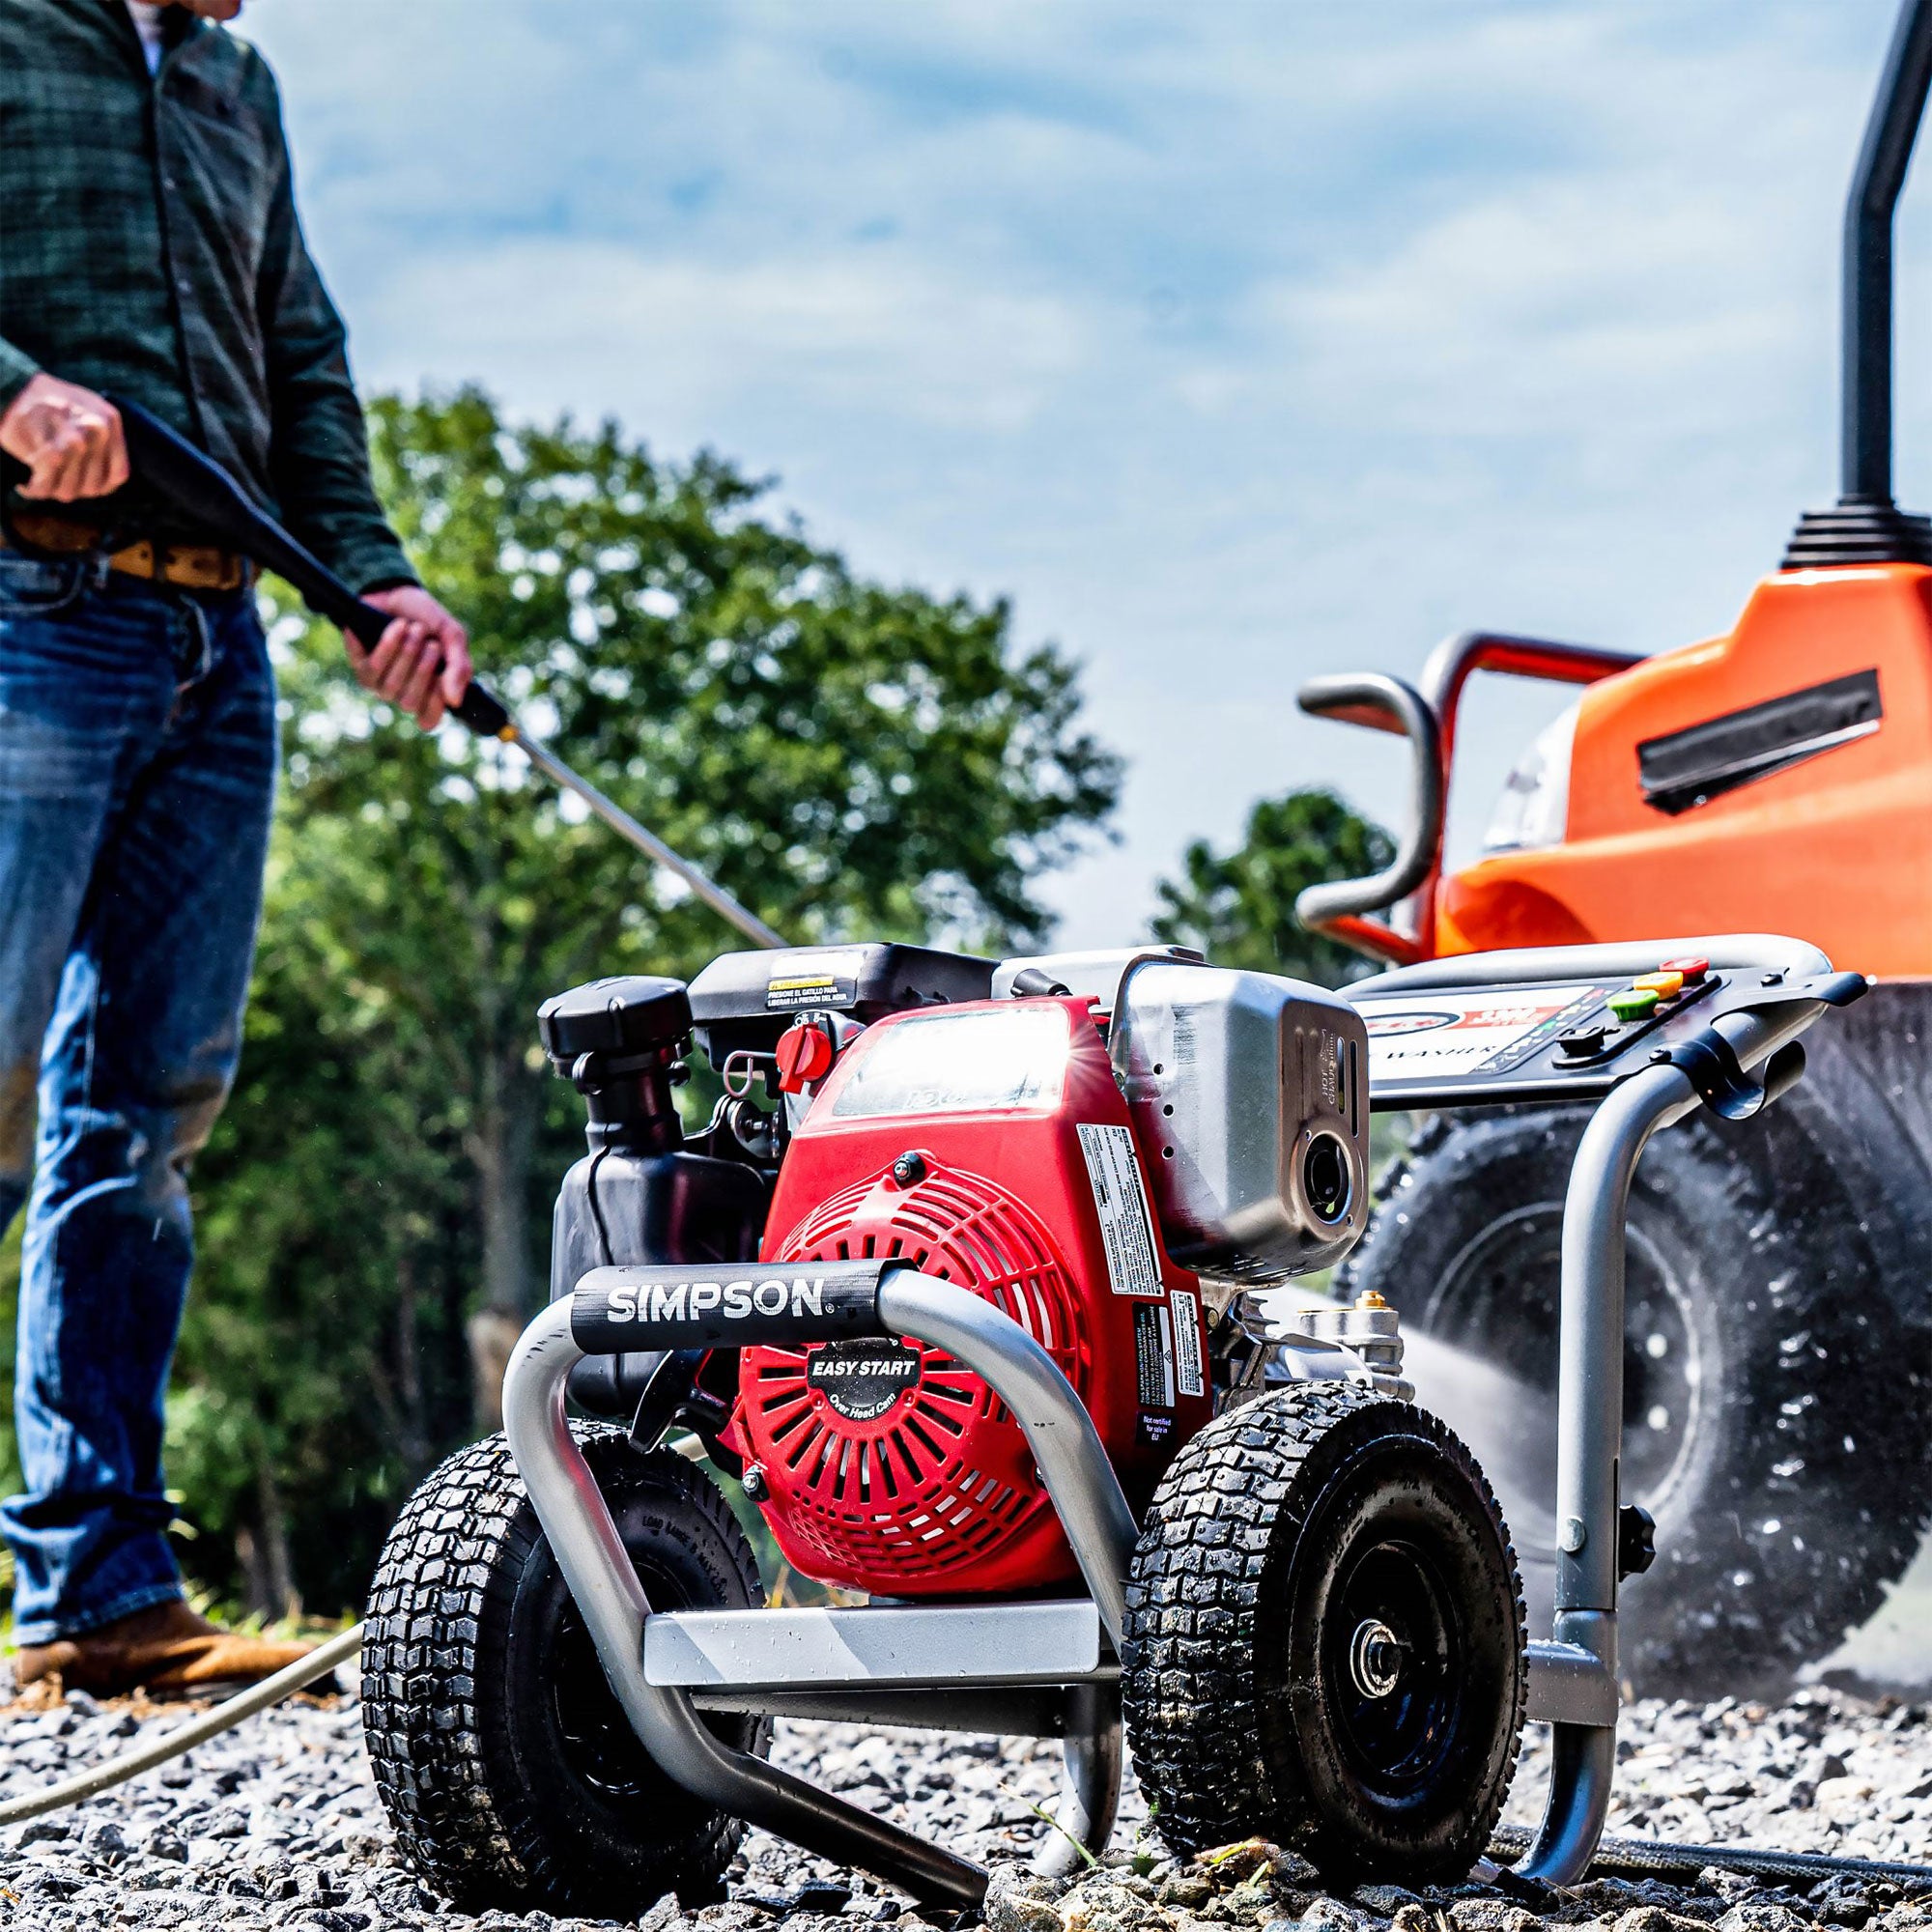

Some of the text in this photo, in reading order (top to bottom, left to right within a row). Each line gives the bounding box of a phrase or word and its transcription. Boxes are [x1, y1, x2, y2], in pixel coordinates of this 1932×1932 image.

[607, 1278, 824, 1322] SIMPSON
[812, 1360, 916, 1377] EASY START
[829, 1393, 896, 1419] Over Head Cam
[1143, 1415, 1152, 1424] Not
